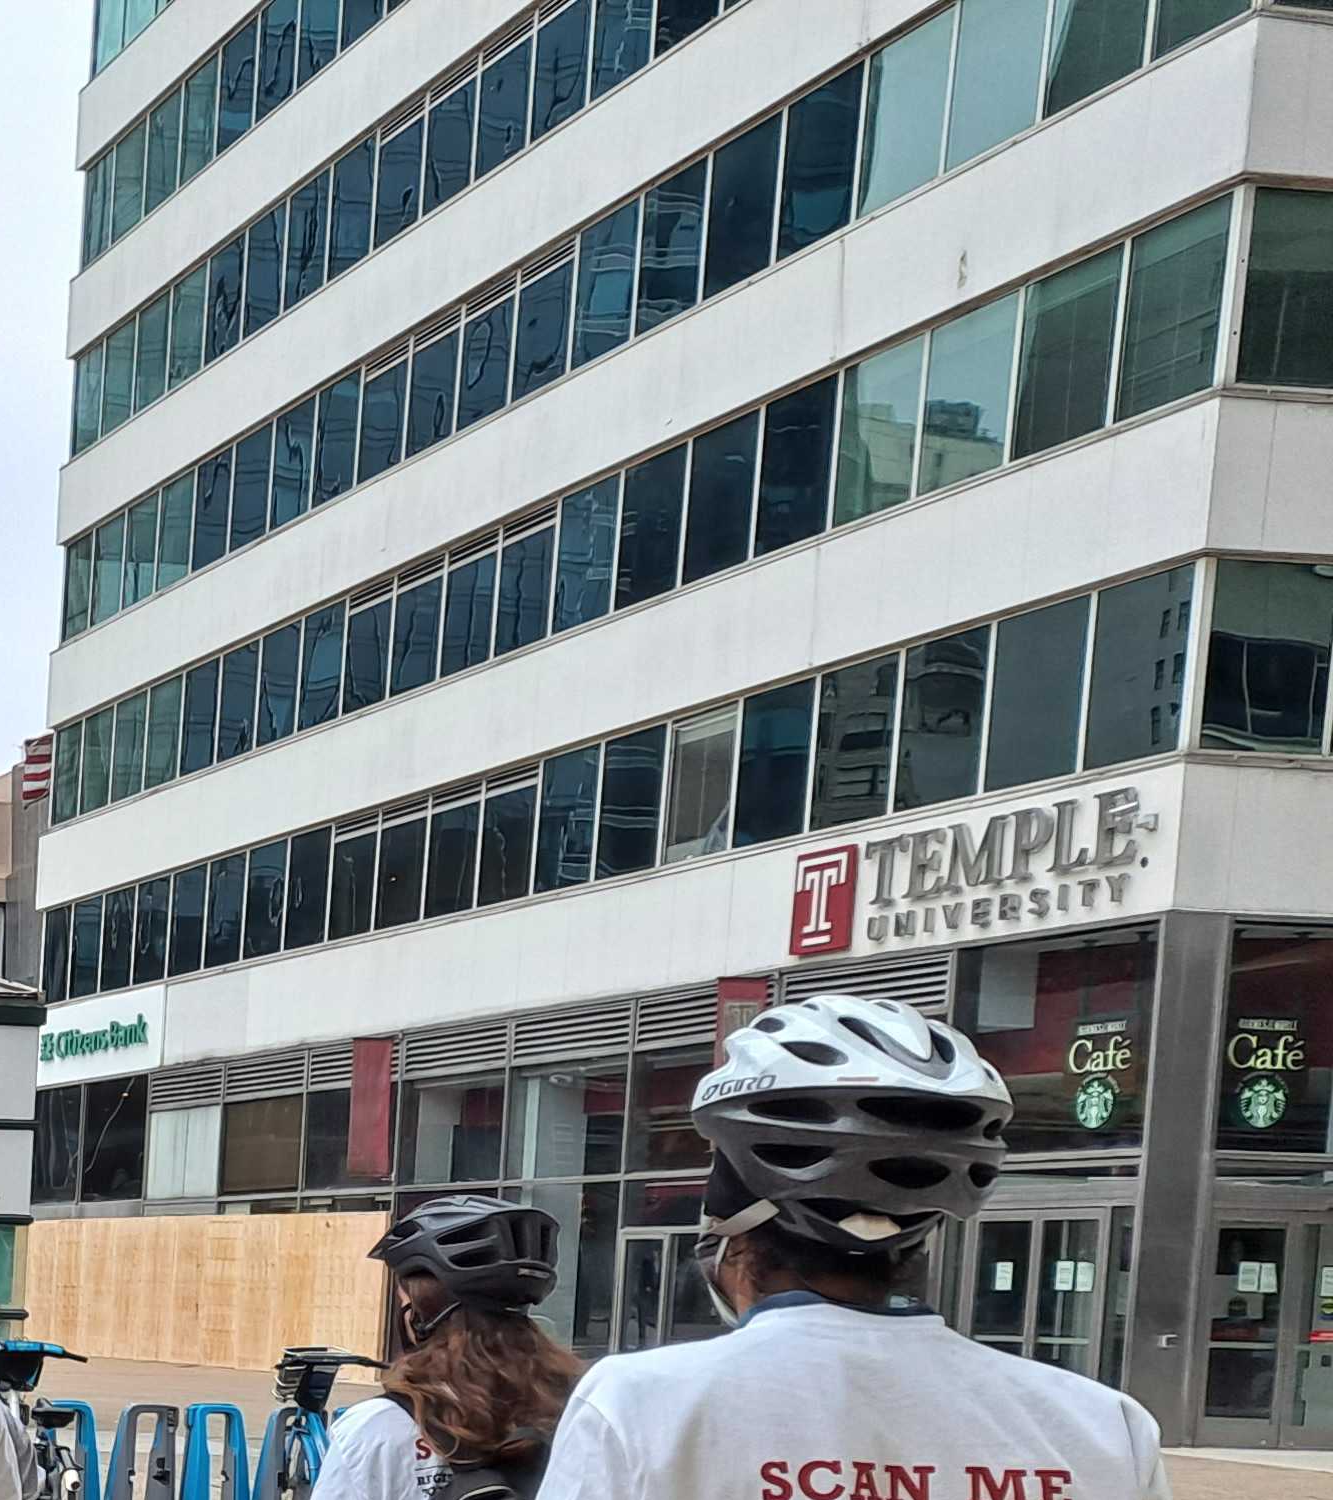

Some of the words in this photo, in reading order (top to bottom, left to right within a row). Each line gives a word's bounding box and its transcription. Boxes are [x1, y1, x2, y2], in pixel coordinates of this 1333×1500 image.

[865, 786, 1141, 908] TEMPLE
[867, 872, 1132, 943] UNIVERSITY
[56, 1029, 108, 1058] Citizens
[109, 1013, 148, 1049] Bank
[1068, 1036, 1132, 1074] Café
[1227, 1033, 1306, 1071] Café
